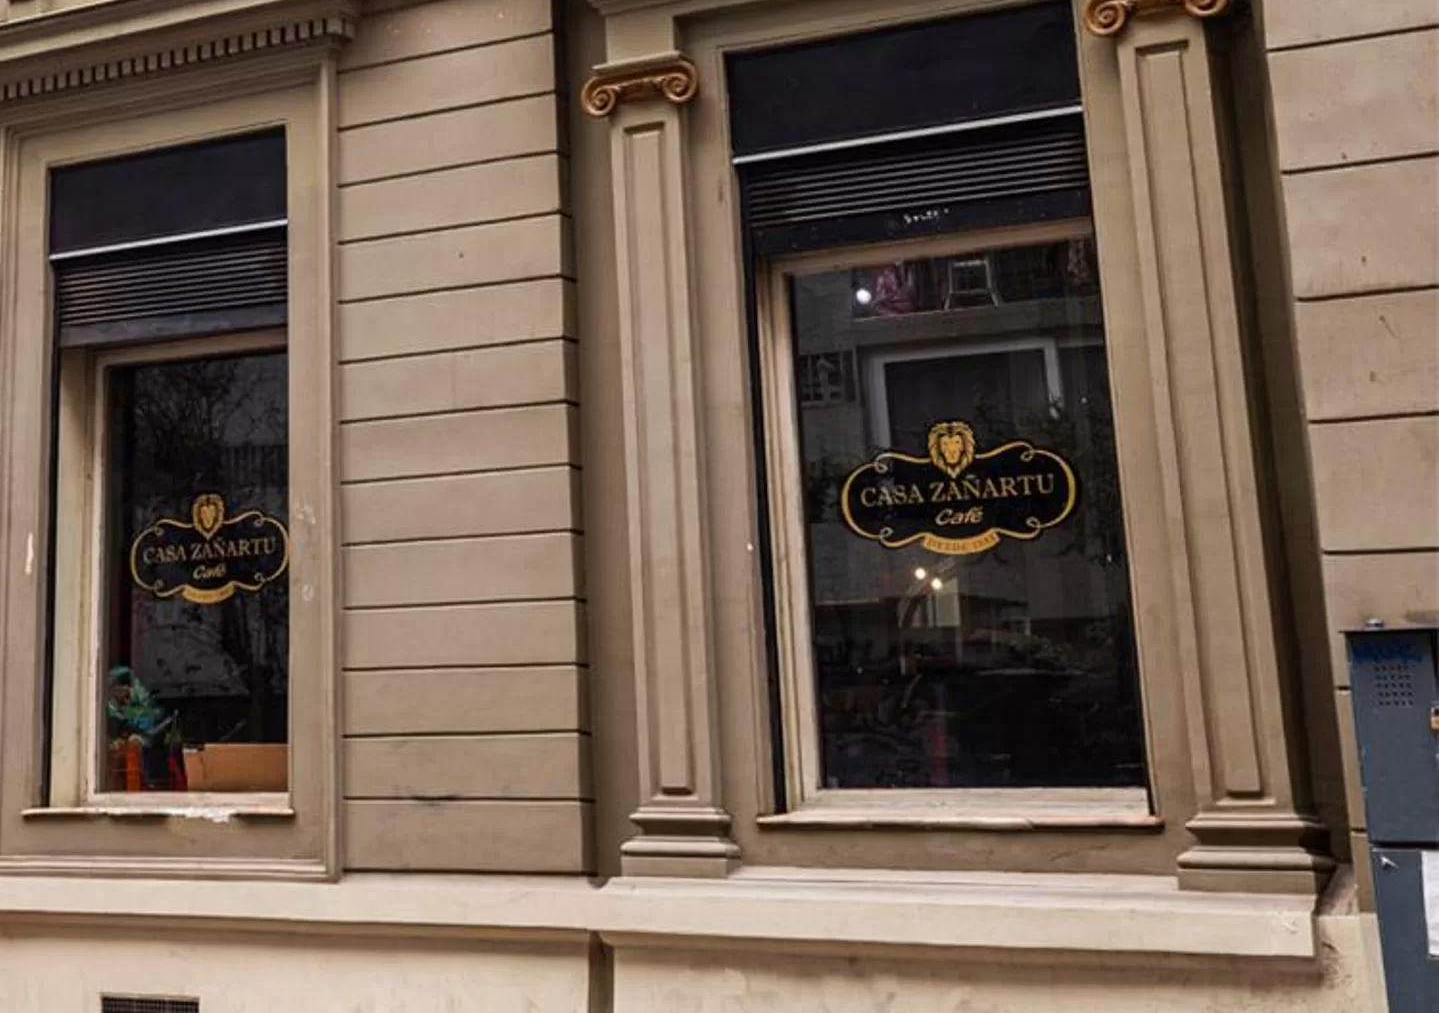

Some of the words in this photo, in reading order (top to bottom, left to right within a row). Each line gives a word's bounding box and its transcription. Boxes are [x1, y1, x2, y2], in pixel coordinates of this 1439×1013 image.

[860, 484, 924, 508] CASA
[930, 473, 1055, 503] ZAÑARTU
[935, 506, 984, 526] Café
[143, 544, 187, 564] CASA
[190, 537, 278, 560] ZAÑARTU
